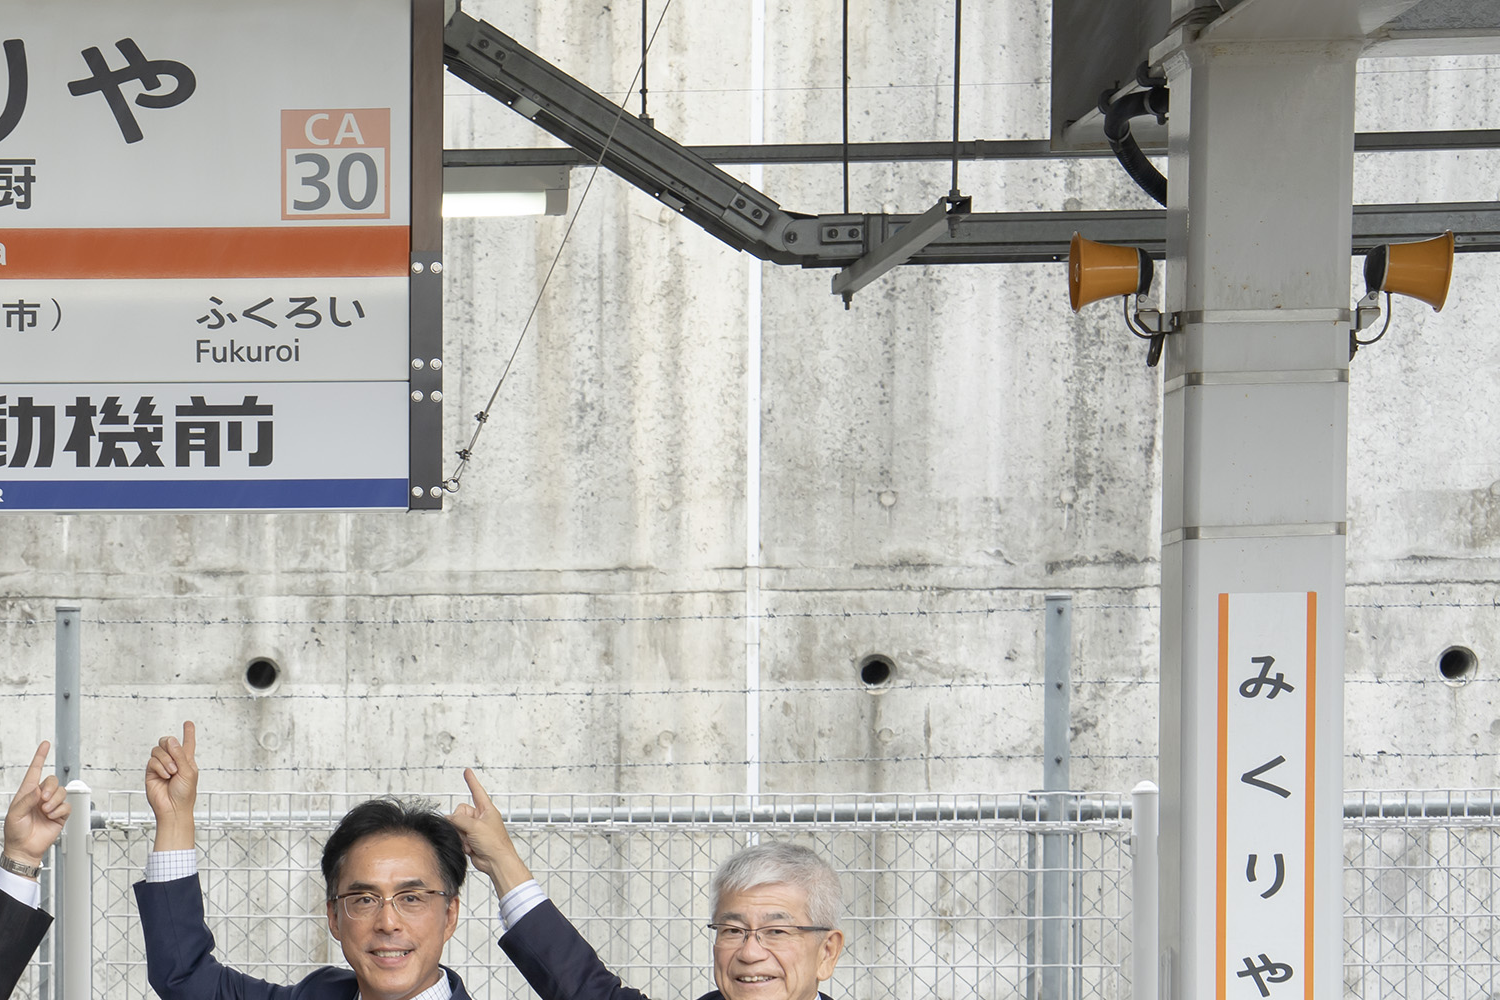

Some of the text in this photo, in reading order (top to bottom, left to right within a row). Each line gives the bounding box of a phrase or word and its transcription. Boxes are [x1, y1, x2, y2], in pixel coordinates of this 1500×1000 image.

[304, 112, 365, 146] CA
[293, 152, 378, 211] 30
[196, 296, 366, 330] ふくろい
[196, 338, 300, 364] Fukuroi
[1236, 655, 1295, 998] みくりや
